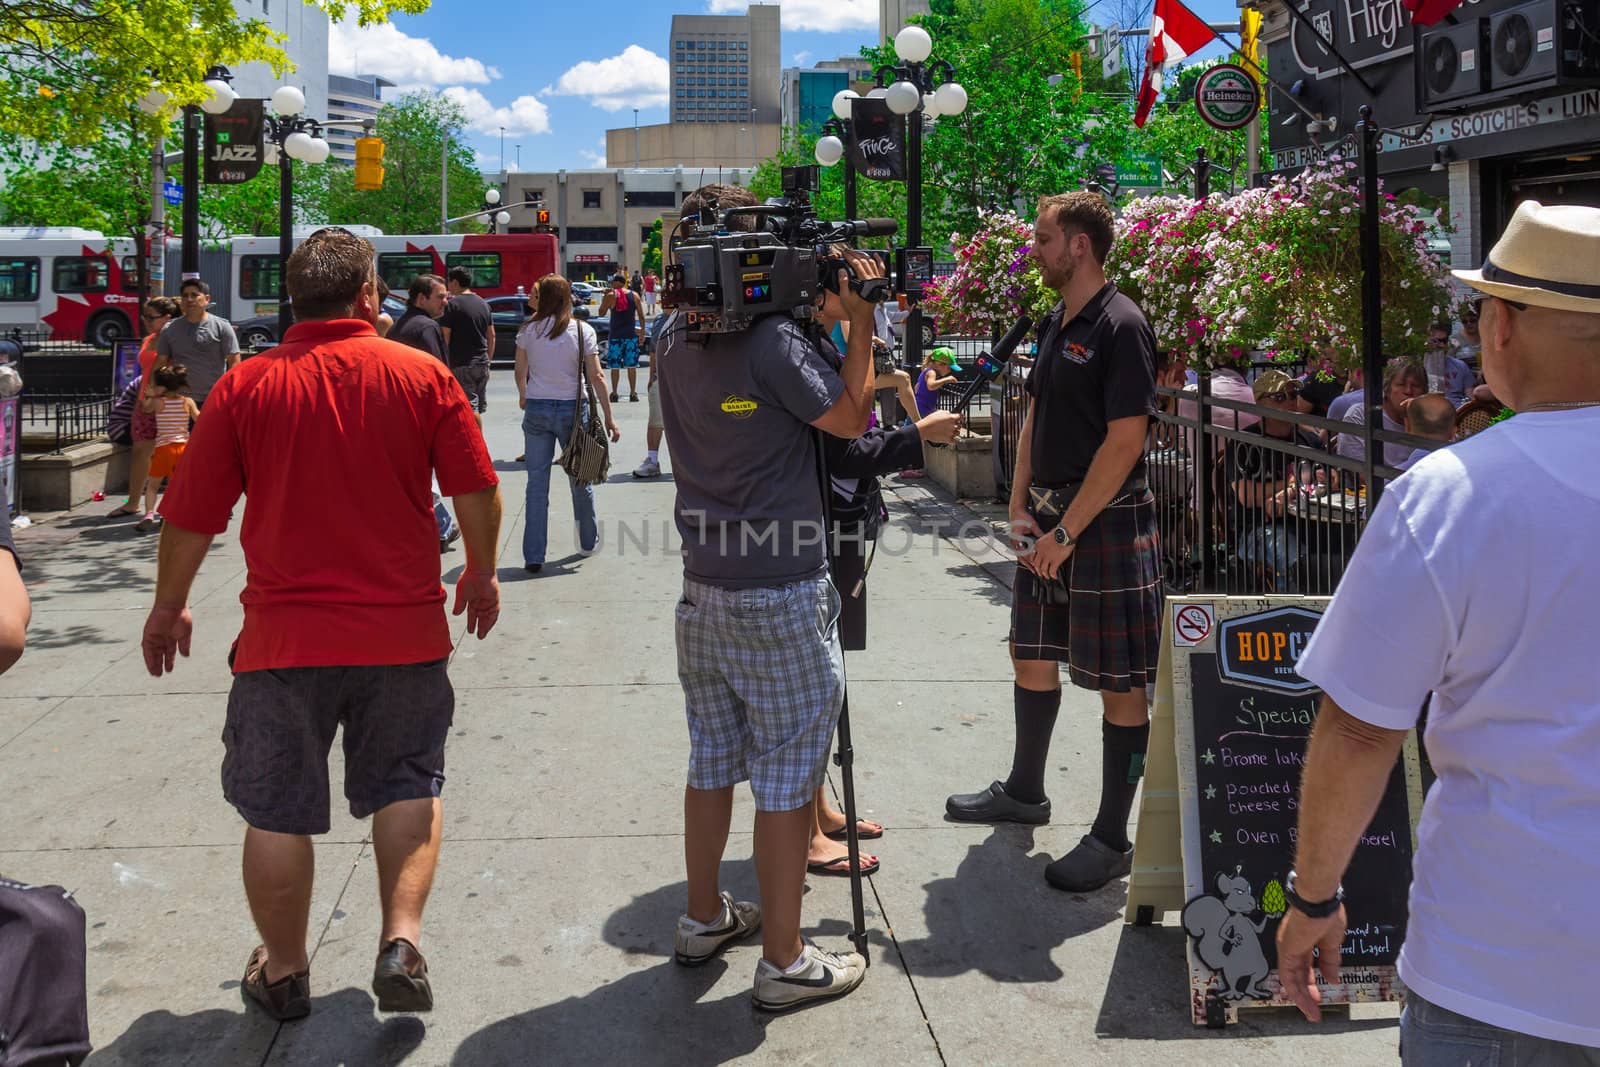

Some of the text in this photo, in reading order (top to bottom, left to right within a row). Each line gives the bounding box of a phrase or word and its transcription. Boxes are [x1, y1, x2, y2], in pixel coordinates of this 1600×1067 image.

[1207, 91, 1252, 101] Heineken
[1277, 151, 1296, 169] PUB
[1451, 103, 1540, 139] SCOTCHES
[211, 145, 257, 161] JAZZ
[745, 285, 769, 296] CTV
[1236, 631, 1313, 661] HOPC
[1274, 666, 1295, 674] BREW
[1221, 747, 1268, 767] Brome
[1236, 828, 1280, 845] Oven
